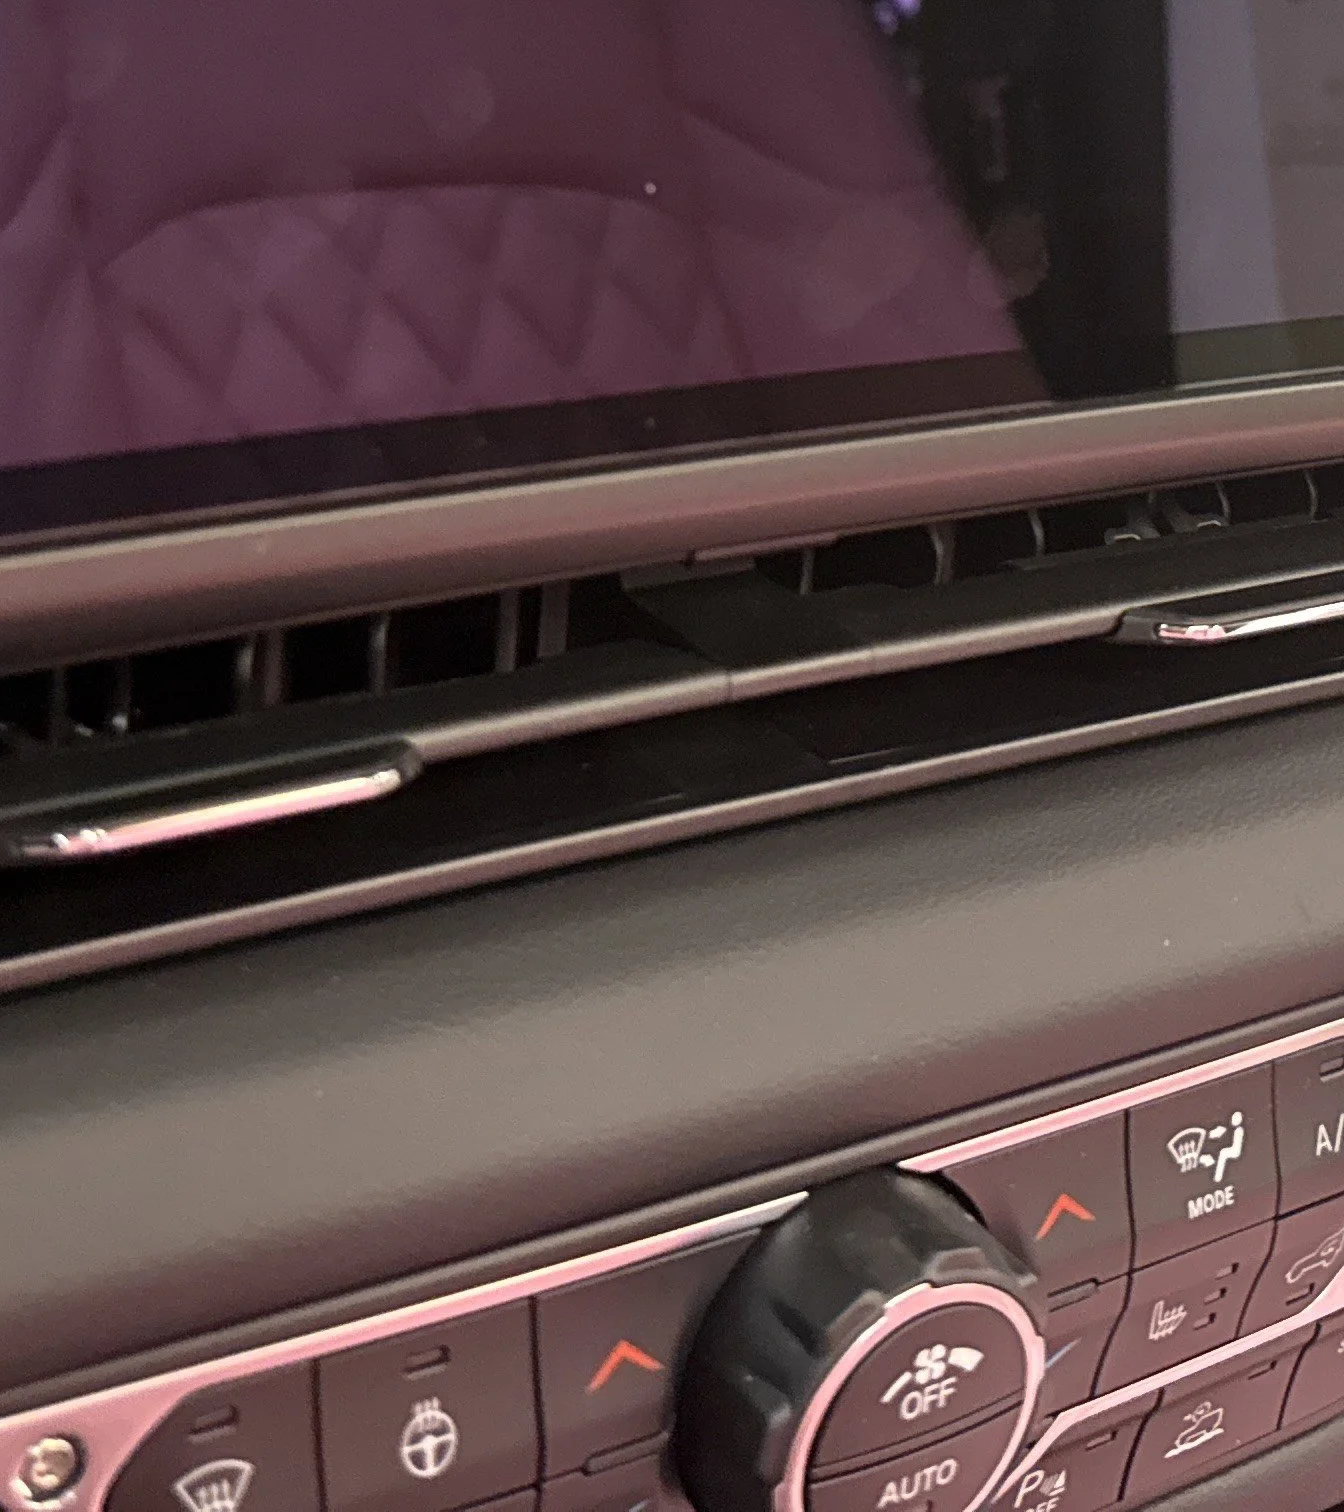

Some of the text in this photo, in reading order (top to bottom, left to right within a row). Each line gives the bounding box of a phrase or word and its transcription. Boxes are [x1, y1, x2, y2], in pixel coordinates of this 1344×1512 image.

[1187, 1186, 1235, 1220] MODE
[899, 1377, 958, 1421] OFF
[876, 1458, 958, 1510] AUTO
